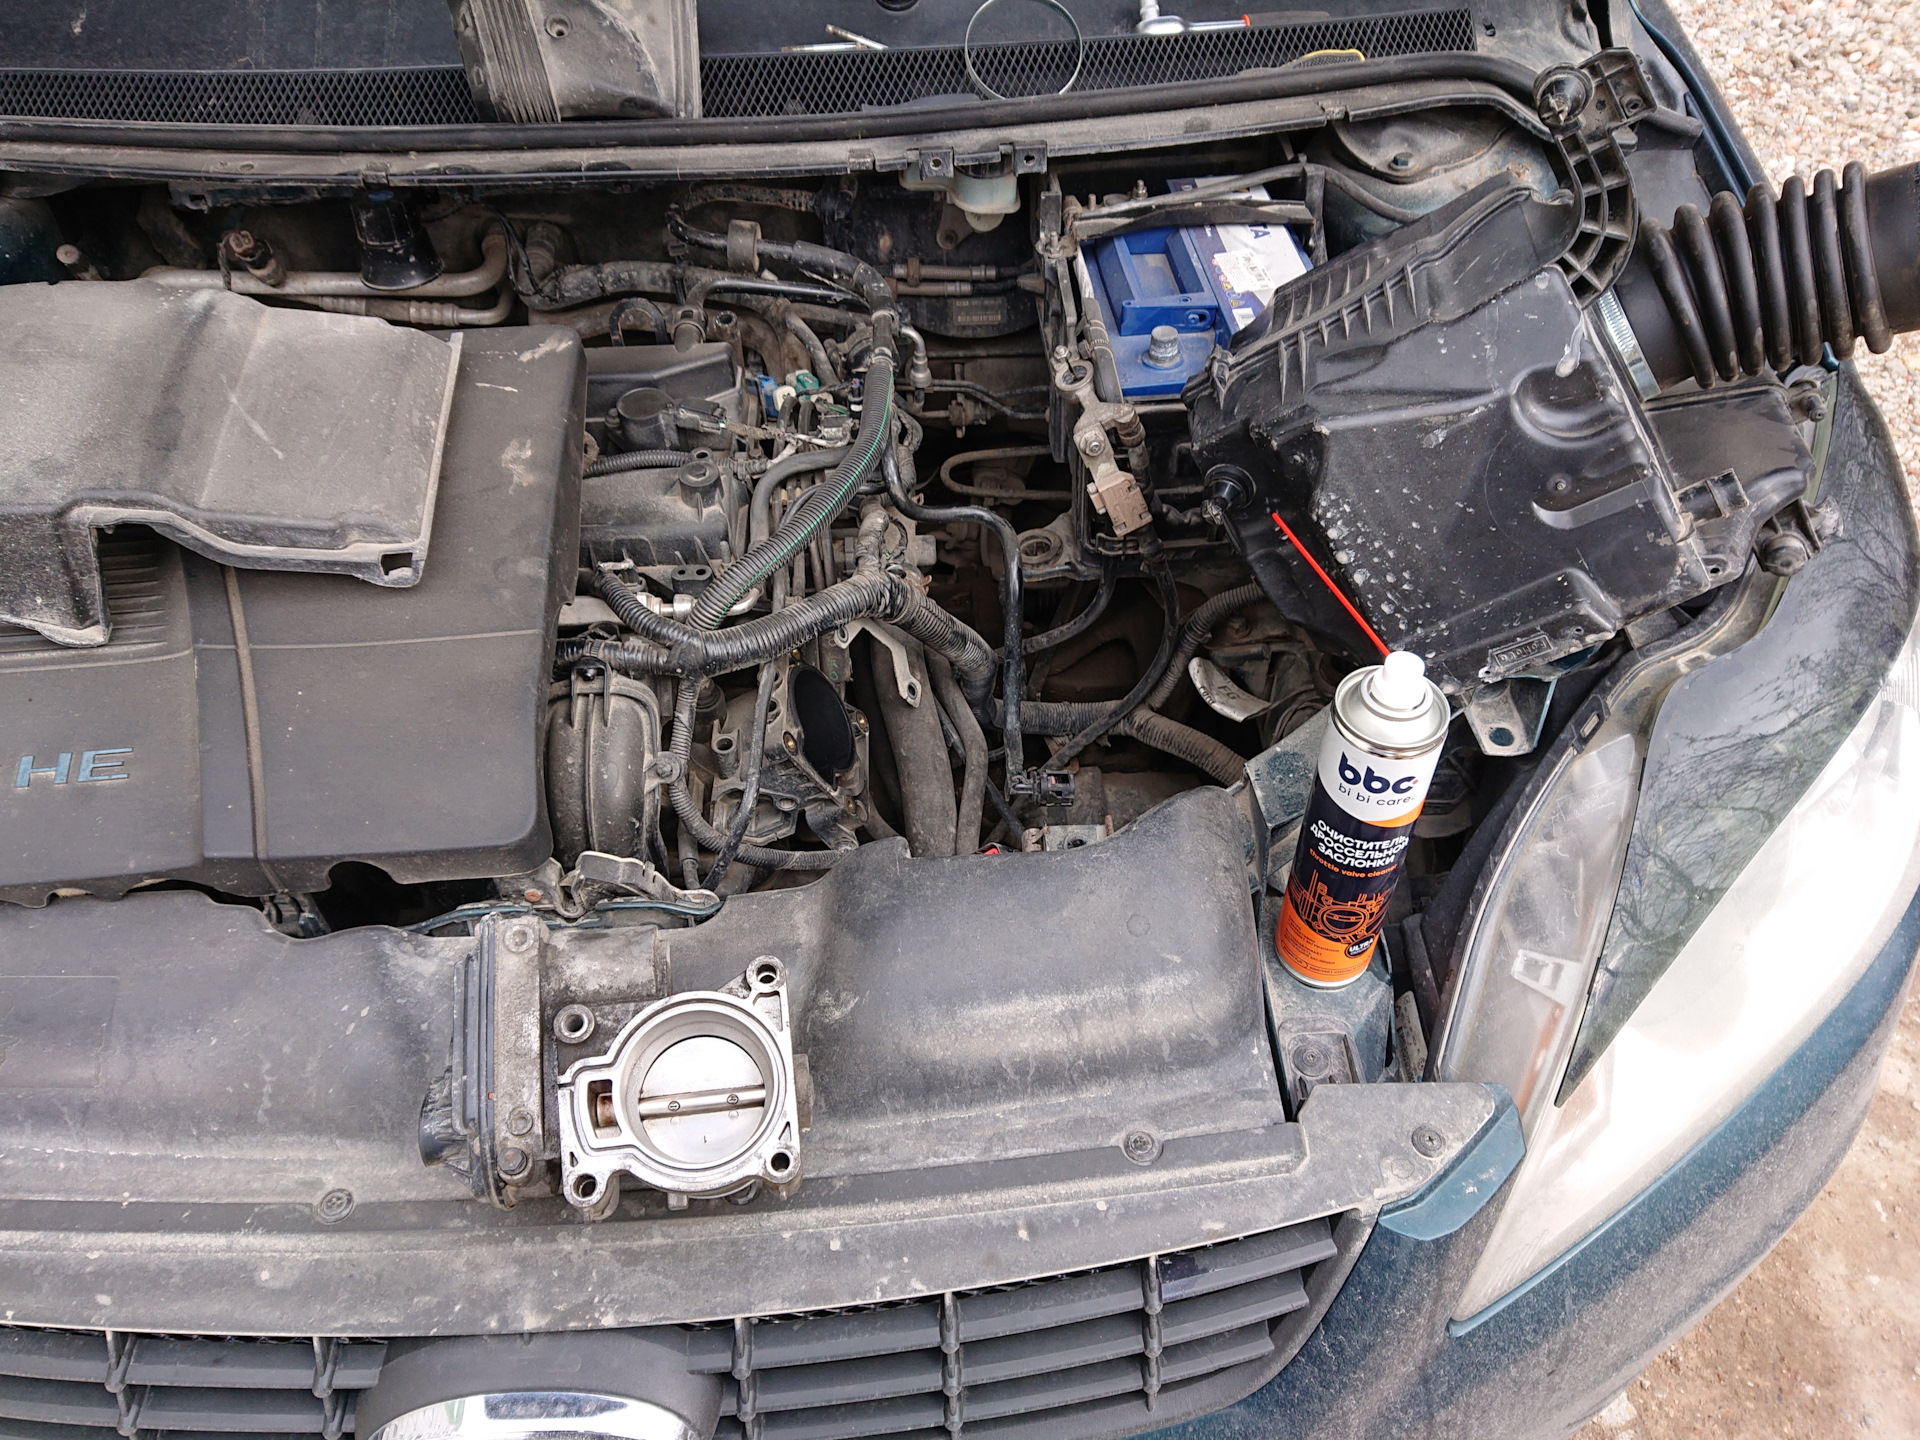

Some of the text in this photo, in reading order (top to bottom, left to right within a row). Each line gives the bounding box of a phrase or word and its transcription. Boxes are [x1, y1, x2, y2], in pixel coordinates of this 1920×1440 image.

[15, 747, 134, 788] HE
[1338, 751, 1417, 794] bbc
[1338, 782, 1351, 796] bi
[1356, 792, 1371, 803] bi
[1309, 823, 1410, 860] ДРОССЕЛЬНОЙ
[1317, 819, 1407, 850] ОЧИСТИТЕЛЬ
[1309, 848, 1399, 878] throttle valve cleaner
[1317, 843, 1396, 869] ЗАСЛОНКИ
[1348, 937, 1374, 952] ULTRA
